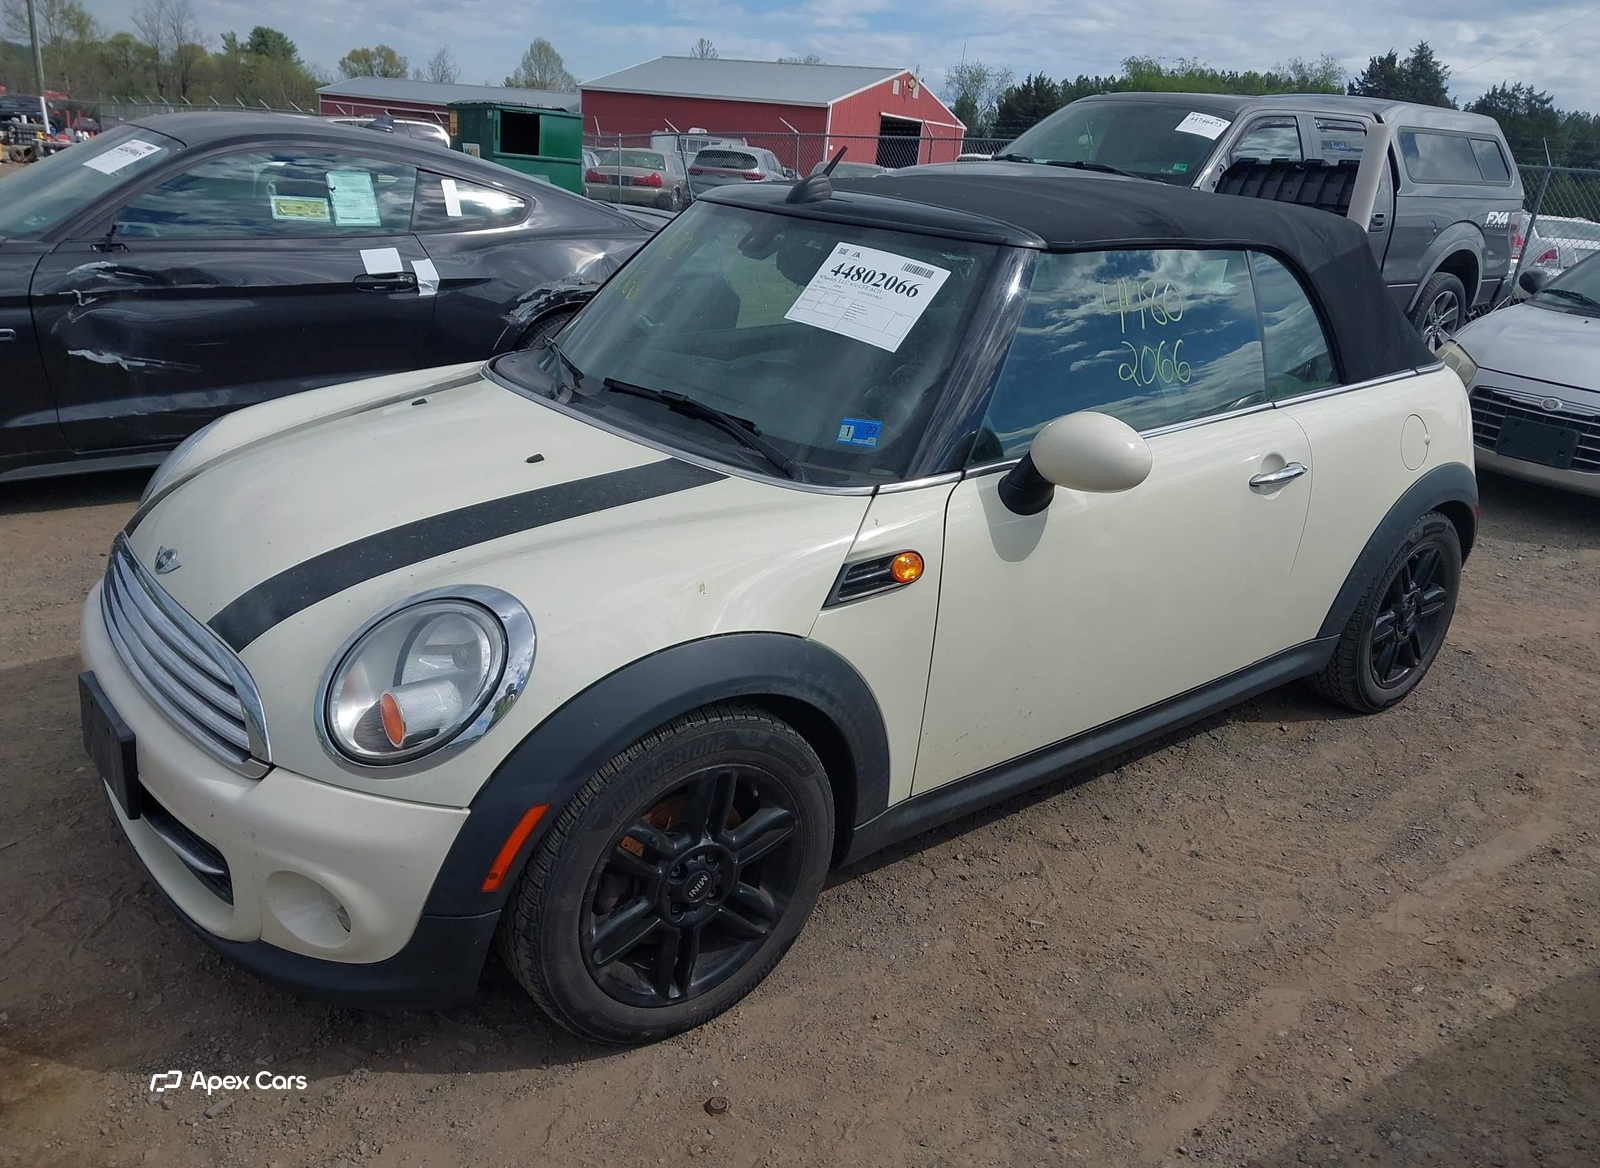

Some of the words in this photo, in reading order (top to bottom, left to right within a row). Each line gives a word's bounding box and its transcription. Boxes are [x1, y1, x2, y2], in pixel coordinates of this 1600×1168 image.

[1485, 211, 1510, 225] FX4
[830, 262, 924, 298] 44802066
[1118, 339, 1191, 387] 2066
[846, 426, 851, 437] 1
[688, 874, 708, 897] MINI
